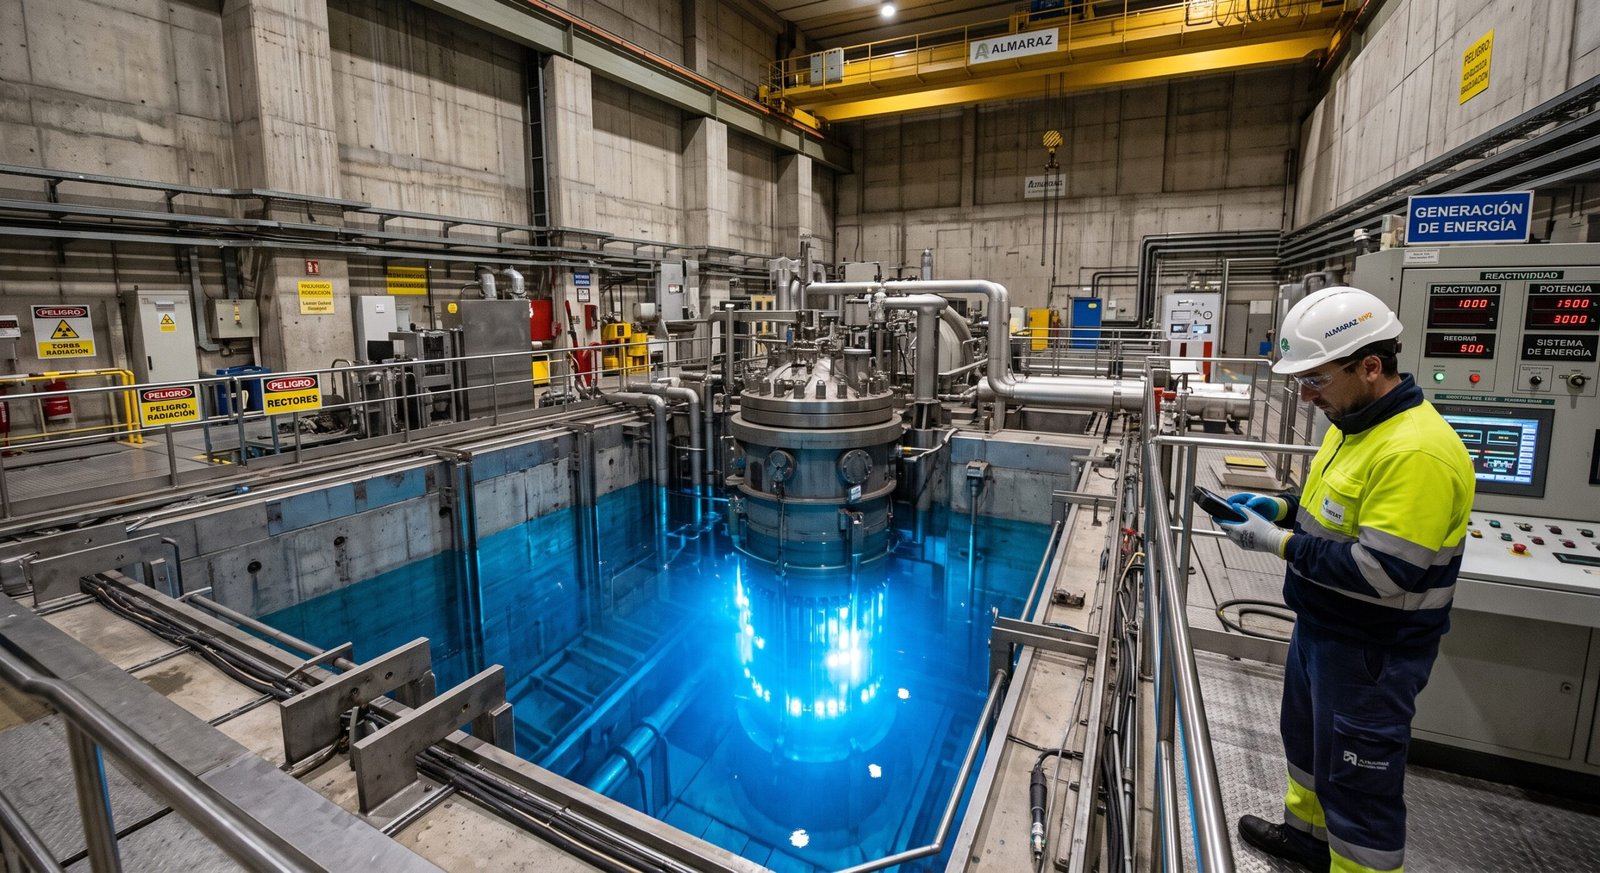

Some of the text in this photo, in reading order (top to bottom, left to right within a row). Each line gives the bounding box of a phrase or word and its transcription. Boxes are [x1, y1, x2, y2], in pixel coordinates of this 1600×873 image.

[991, 35, 1053, 54] ALMARAZ
[1415, 201, 1523, 218] GENERACIÓN
[1418, 217, 1517, 234] DE ENERGÍA
[1539, 285, 1592, 293] POTENCIA
[1458, 299, 1488, 308] 1000
[1556, 299, 1589, 308] 1500
[41, 307, 81, 316] PELIGRO
[1553, 315, 1588, 324] 3000
[1324, 319, 1359, 339] ALMARAZ
[1536, 339, 1583, 347] SISTEMA
[1460, 344, 1484, 353] 500
[1527, 347, 1592, 357] DE ENERGÍA
[271, 380, 311, 389] PELIGRO
[148, 390, 188, 399] PELIGRO
[267, 395, 318, 408] RECTORES
[150, 403, 190, 413] PELIGRO:
